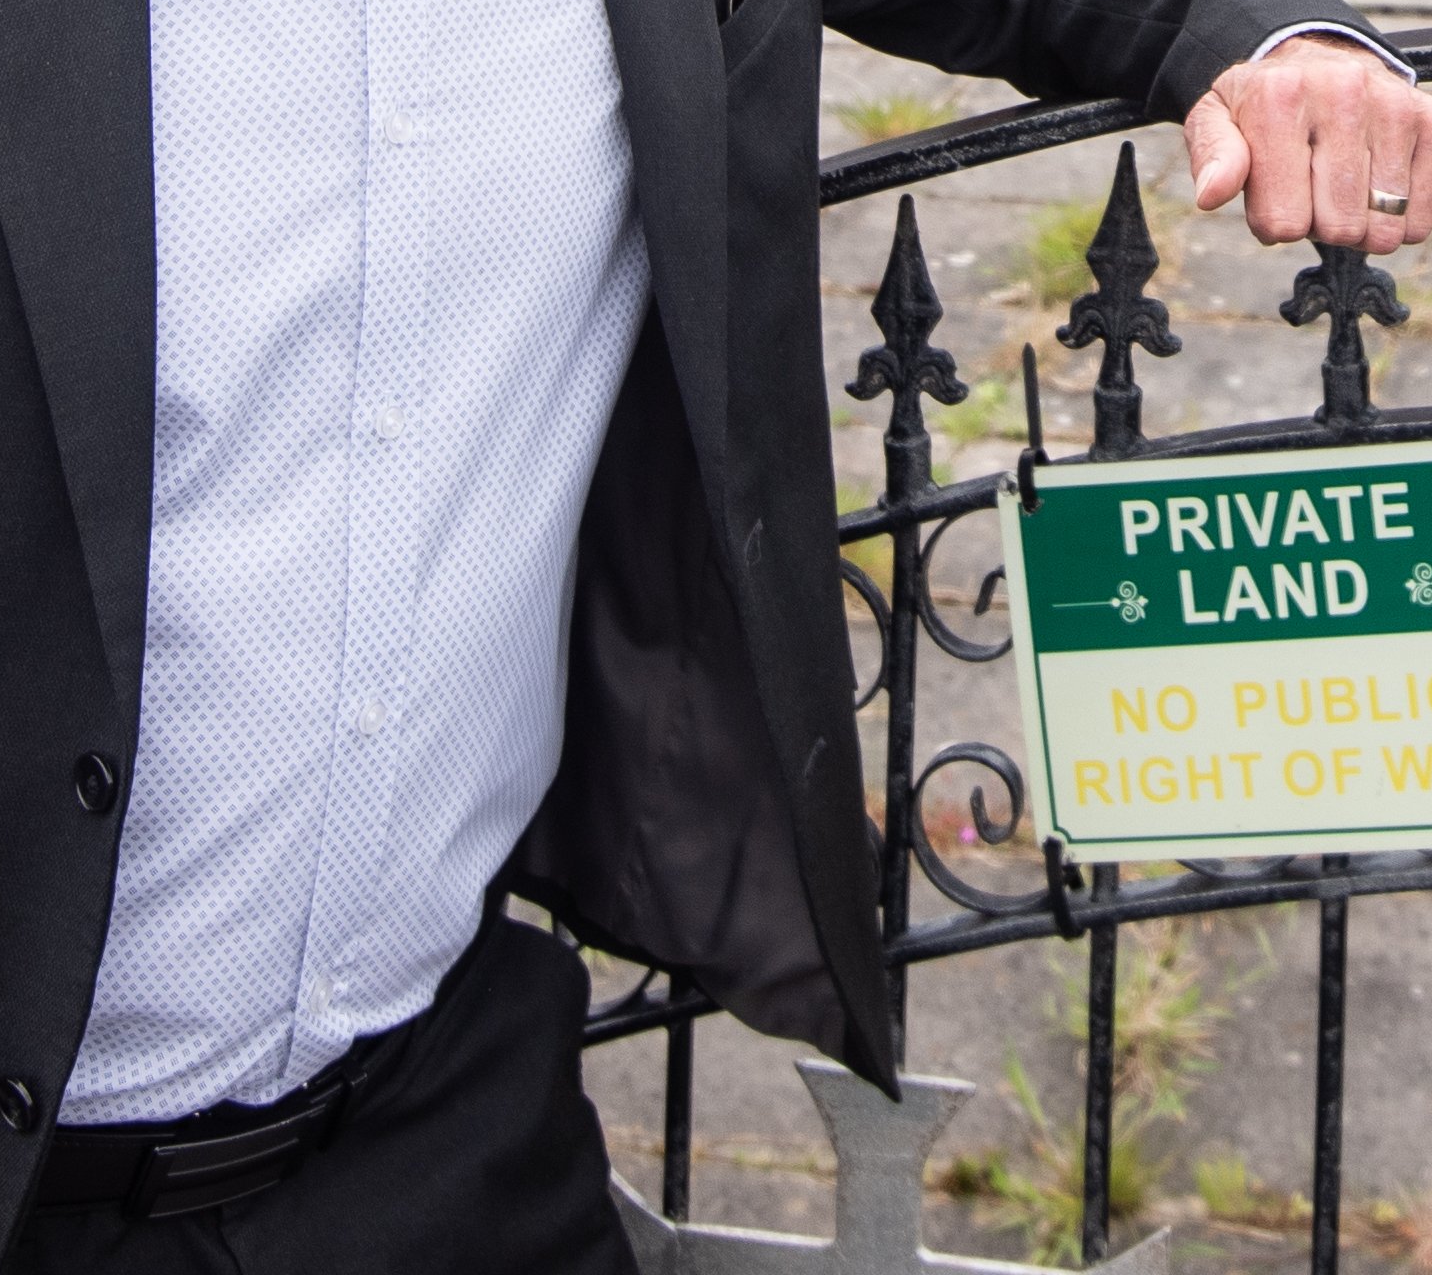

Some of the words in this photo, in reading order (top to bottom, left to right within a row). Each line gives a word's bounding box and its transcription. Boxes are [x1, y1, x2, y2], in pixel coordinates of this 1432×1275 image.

[1120, 482, 1414, 555] PRIVATE
[1178, 559, 1368, 624] LAND
[1110, 684, 1198, 735] NO
[1073, 751, 1263, 807] RIGHT
[1282, 748, 1362, 799] OF
